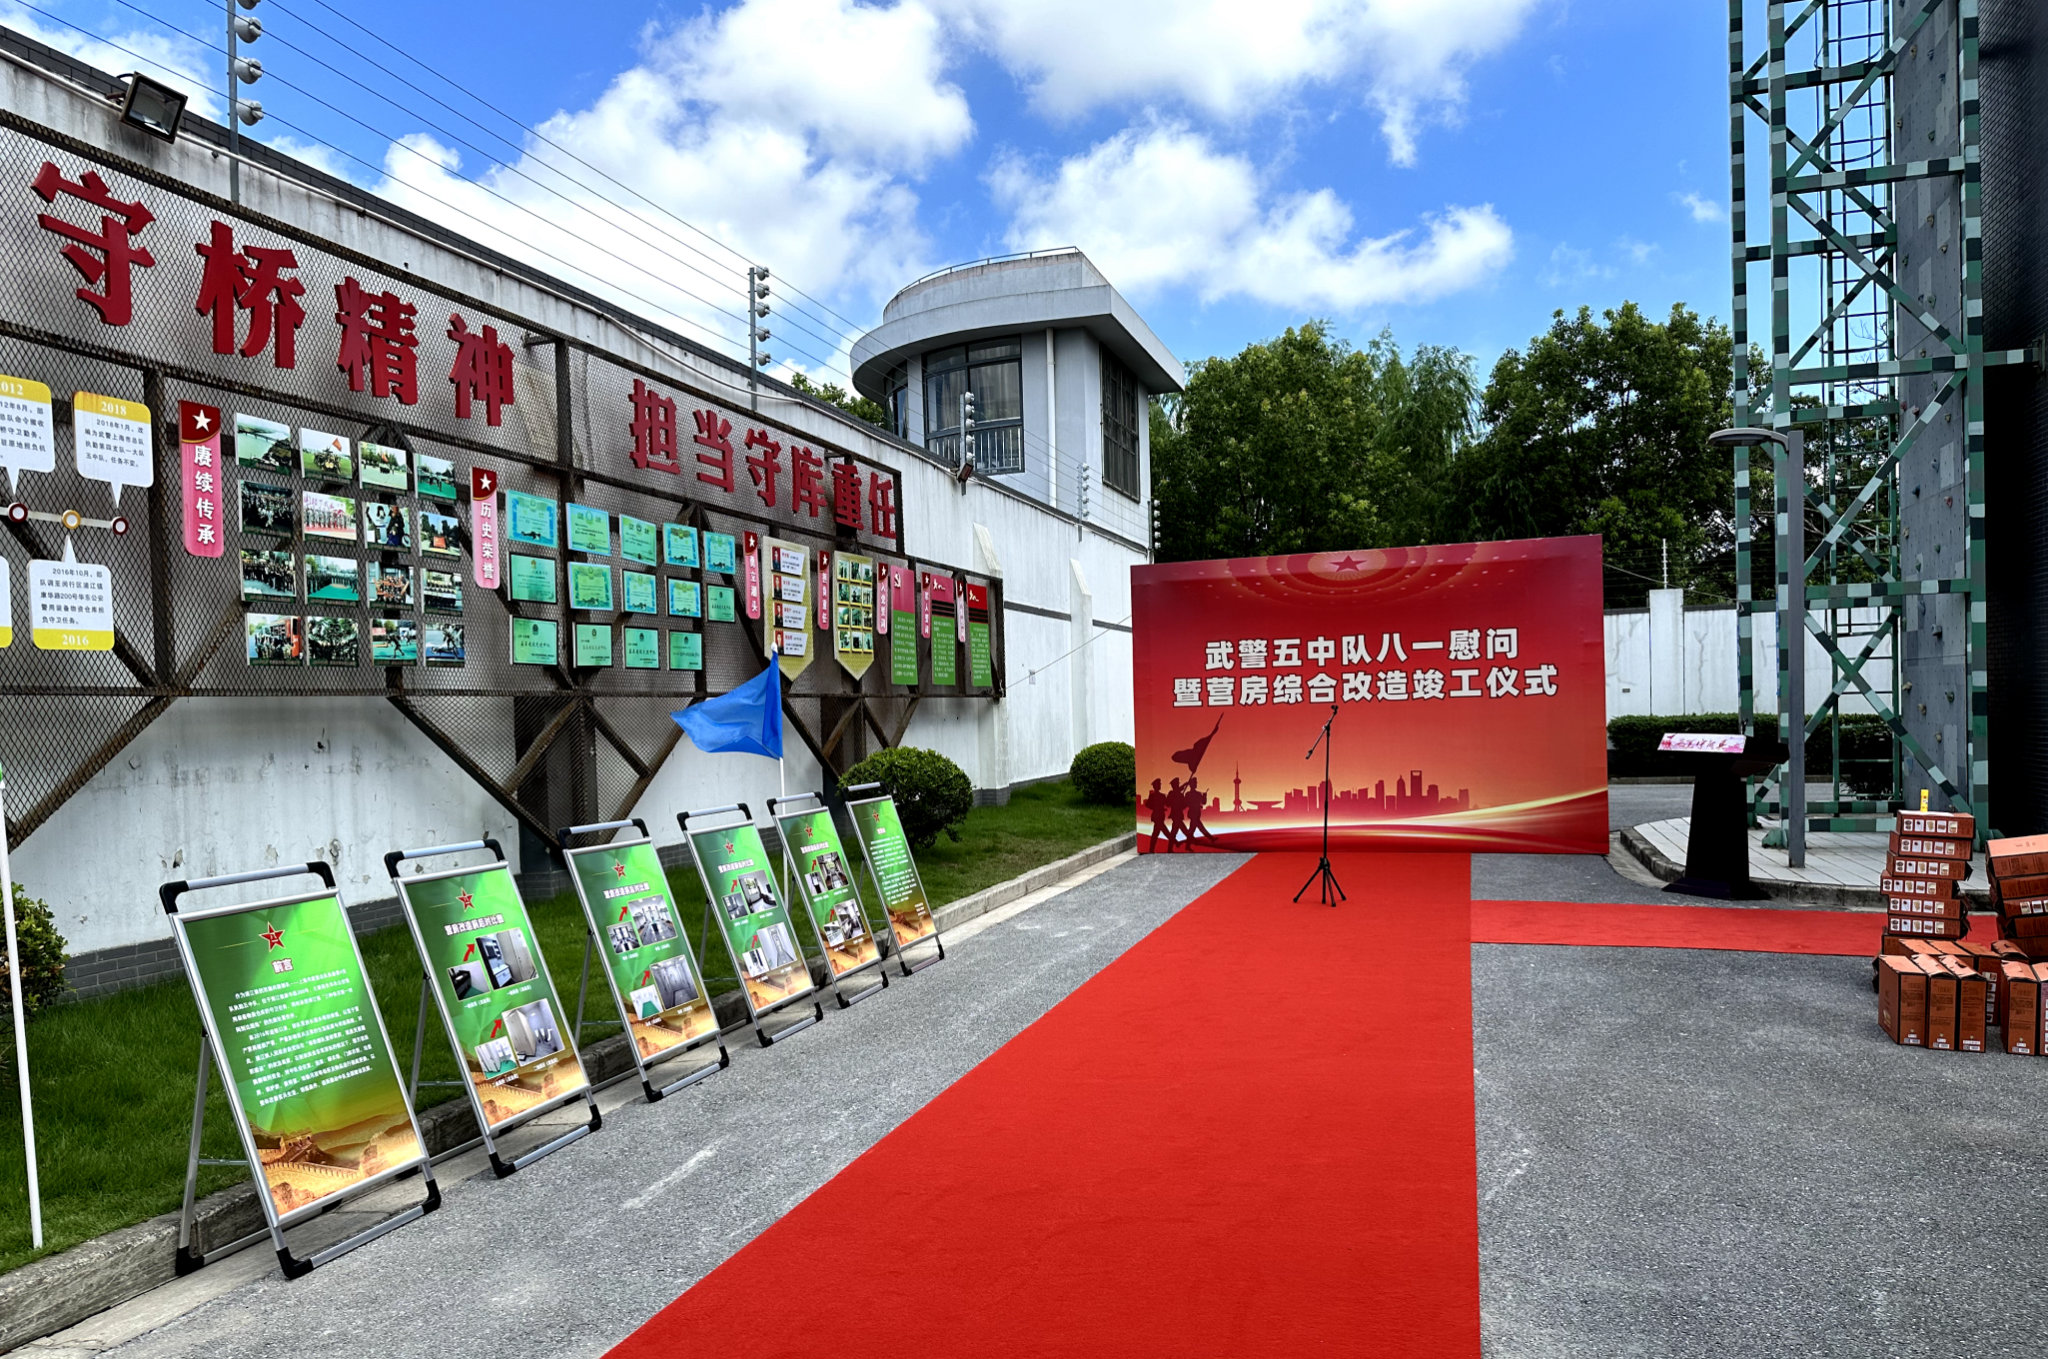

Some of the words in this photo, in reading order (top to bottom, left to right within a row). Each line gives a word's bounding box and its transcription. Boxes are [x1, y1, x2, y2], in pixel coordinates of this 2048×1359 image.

[30, 161, 515, 427] 守桥精神
[629, 379, 896, 540] 担当守库重任
[101, 401, 127, 416] 2018
[194, 445, 215, 545] 赓续传承
[481, 502, 494, 579] 历史荣誉
[62, 634, 89, 646] 2016
[1205, 627, 1519, 671] 武警五中队八一慰问
[1173, 665, 1558, 708] 暨营房综合改造竣工仪式
